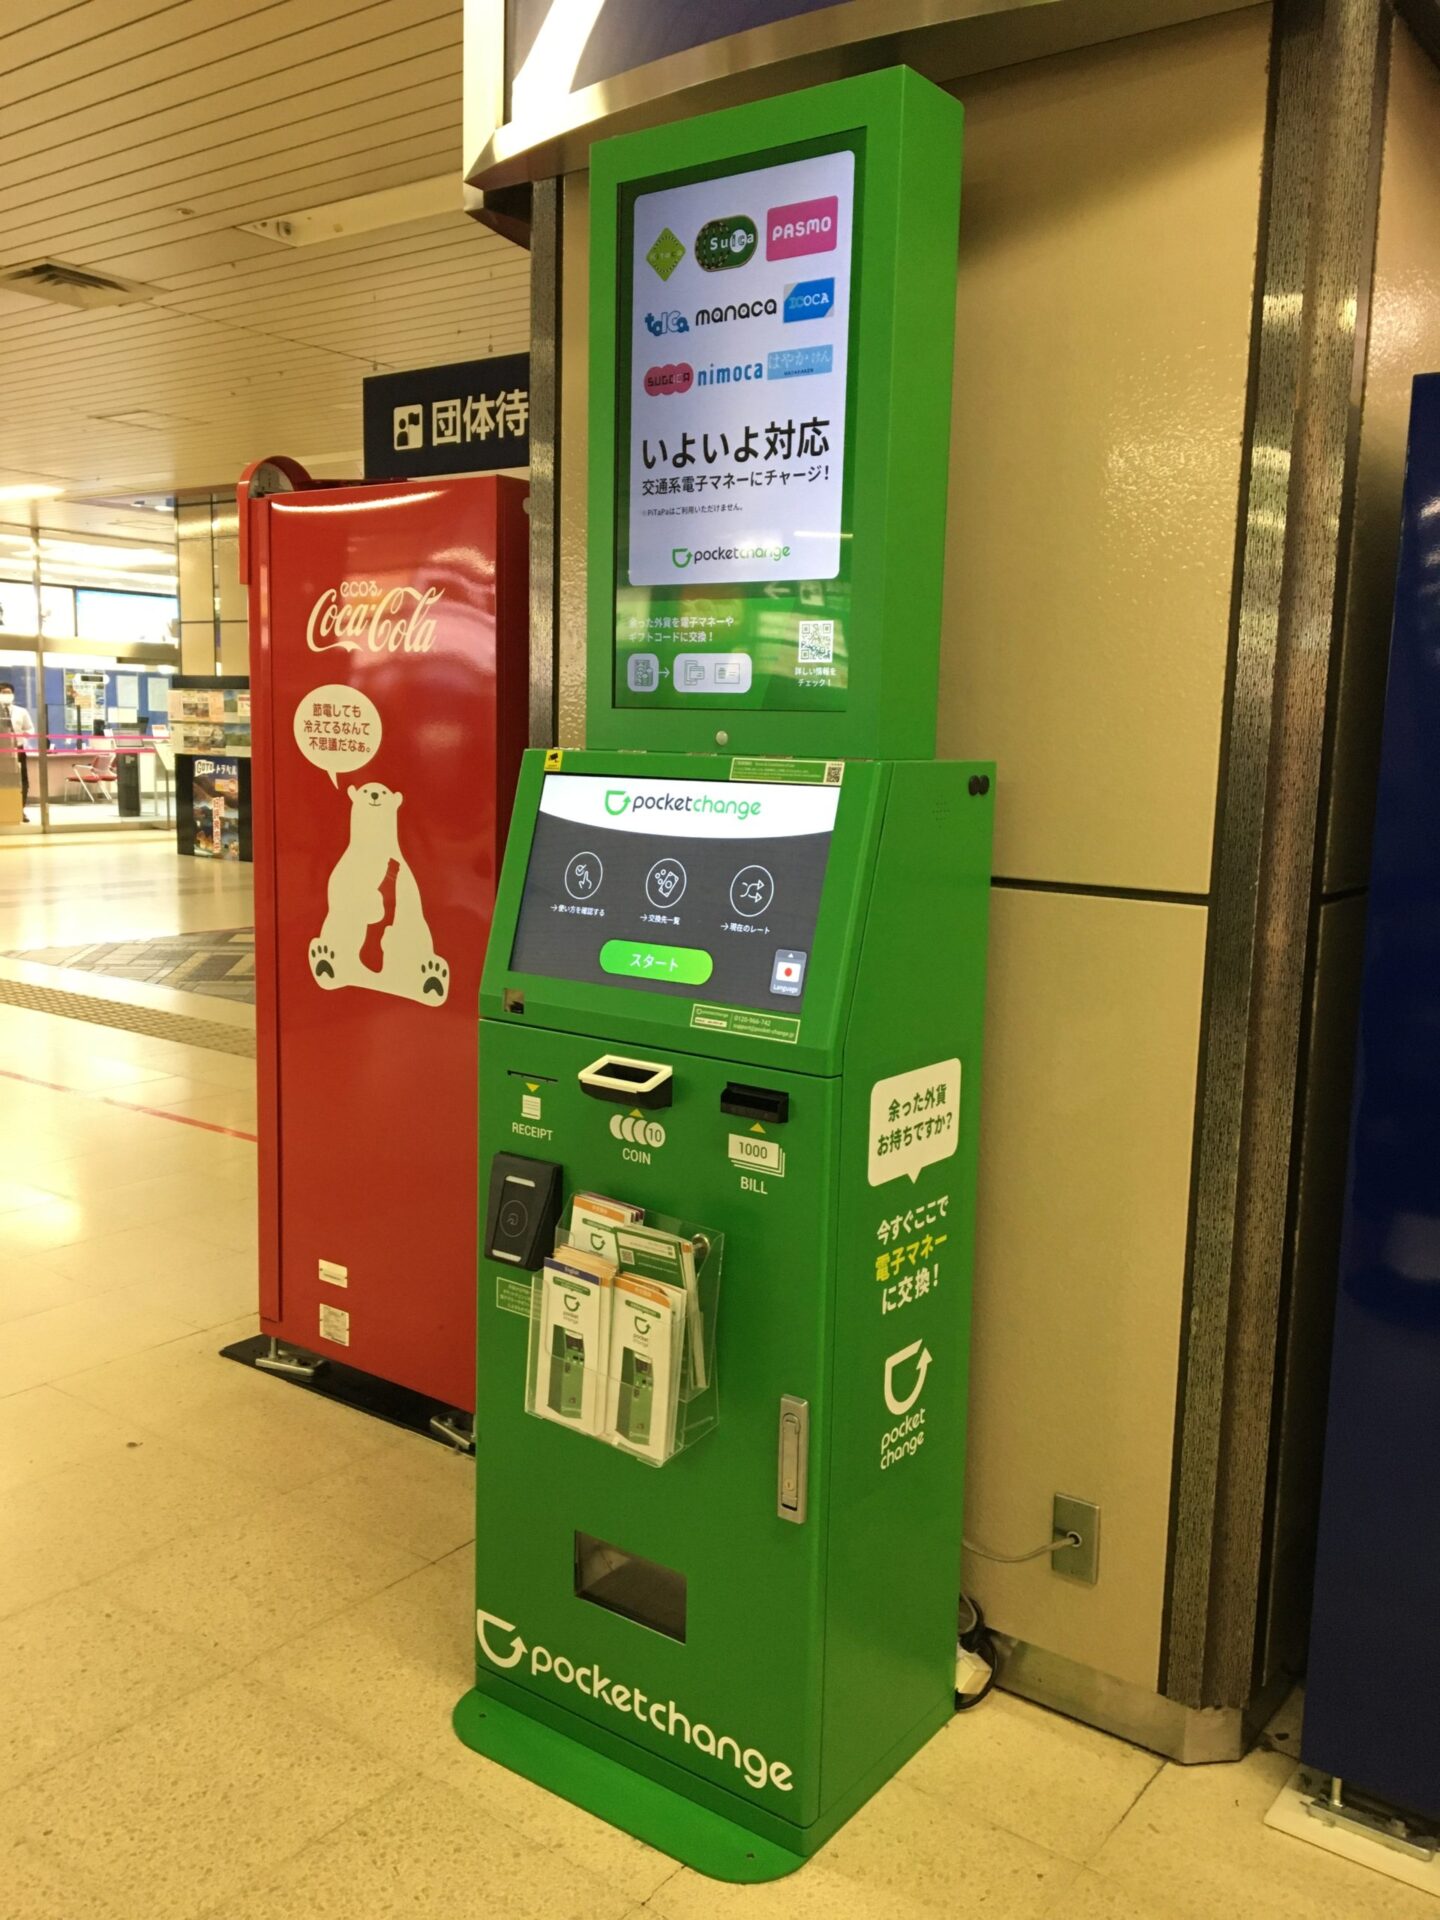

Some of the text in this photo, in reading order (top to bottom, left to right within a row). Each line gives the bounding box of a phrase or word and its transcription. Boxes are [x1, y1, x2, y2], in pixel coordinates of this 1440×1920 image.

[772, 216, 832, 241] PASMO
[710, 233, 754, 250] Suica
[695, 298, 777, 326] manaca
[789, 292, 830, 309] ICOCA
[697, 362, 763, 387] nimoca
[432, 388, 529, 447] 団体待
[642, 417, 830, 470] いよいよ対応
[306, 586, 446, 653] Coca-Cola
[312, 703, 362, 718] 節電しても
[303, 720, 370, 736] 冷えてるなんて
[632, 792, 762, 820] pocketchange
[729, 922, 771, 935] 現在のレート
[629, 953, 679, 973] スタート
[773, 984, 798, 994] Language
[888, 1083, 947, 1123] 余った外貨
[511, 1122, 554, 1143] RECEIPT
[648, 1128, 662, 1145] 10
[622, 1148, 651, 1165] COIN
[738, 1141, 768, 1161] 1000
[740, 1176, 768, 1195] BILL
[877, 1196, 949, 1246] 今すぐここで
[875, 1235, 948, 1282] 電子マネー
[881, 1408, 926, 1455] pocket
[880, 1431, 925, 1471] change
[531, 1645, 793, 1792] pocketchange
